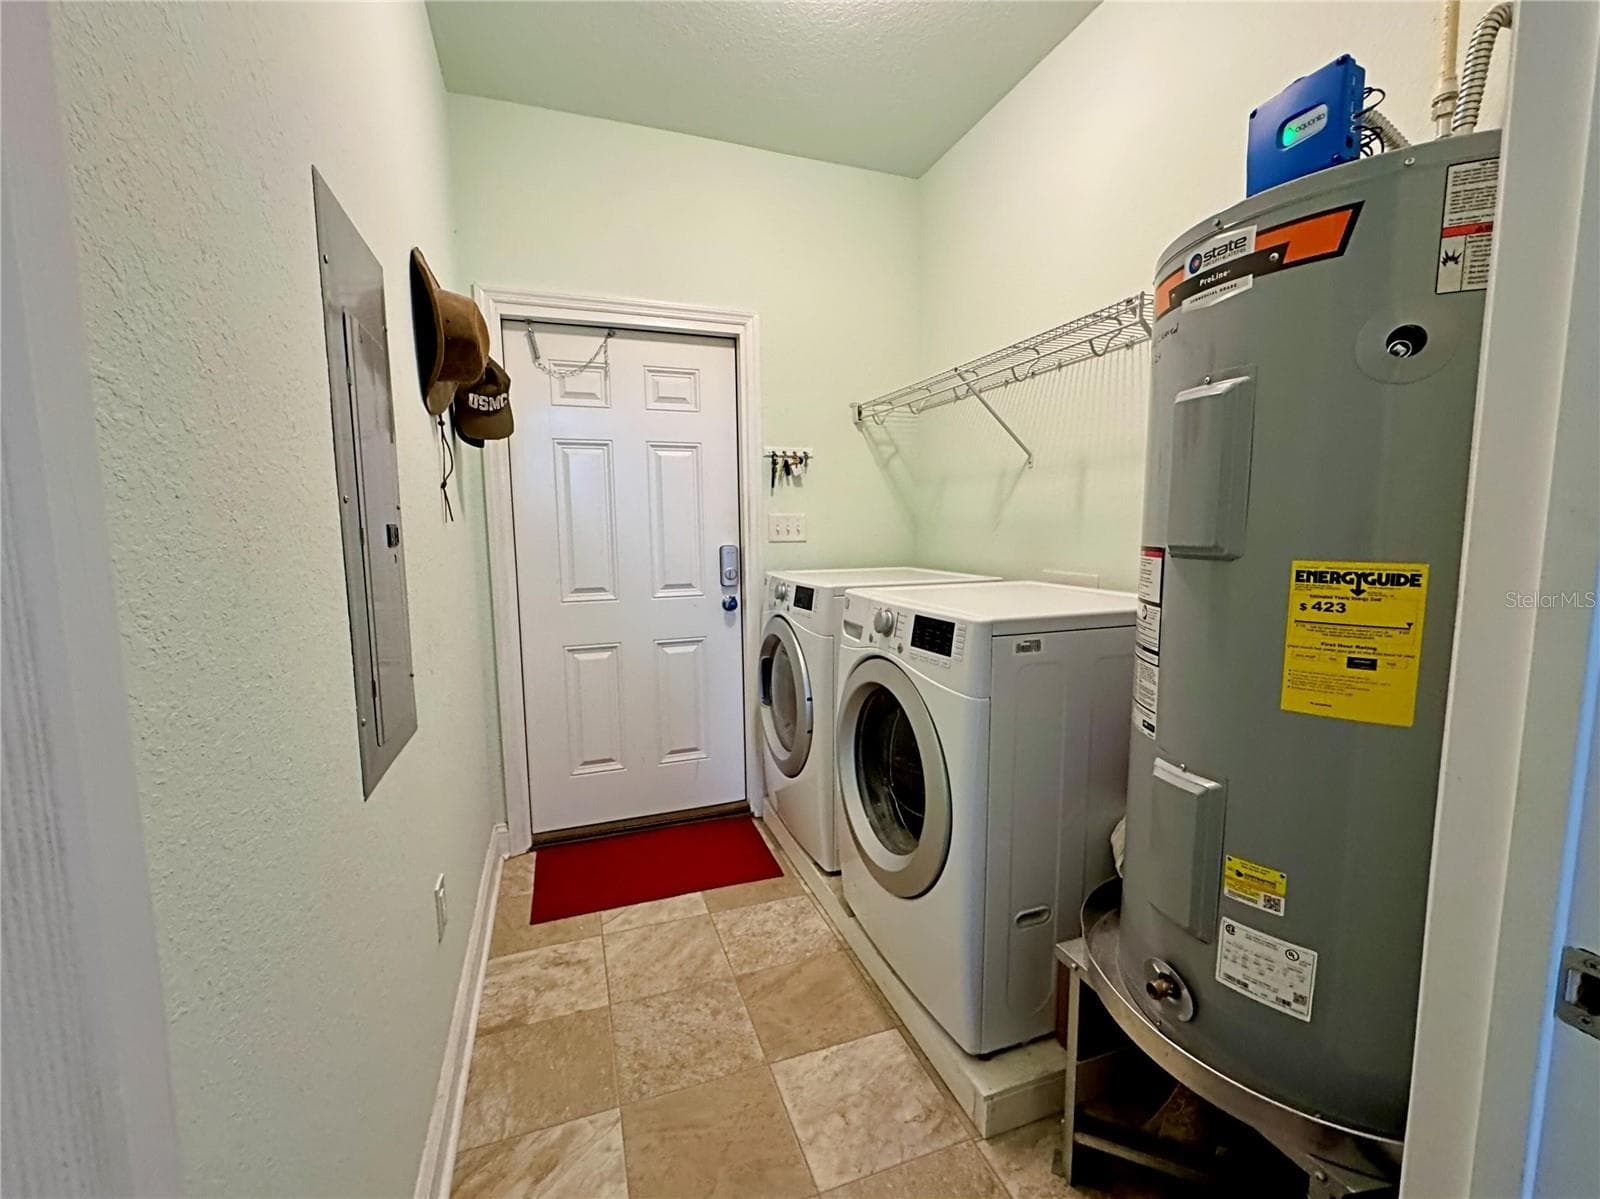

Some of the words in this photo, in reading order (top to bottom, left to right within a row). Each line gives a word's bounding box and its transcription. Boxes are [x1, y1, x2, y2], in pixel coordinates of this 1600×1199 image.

[1203, 236, 1247, 263] state
[468, 393, 508, 412] USMC
[1295, 569, 1423, 588] ENERGYGUIDE
[1311, 601, 1347, 613] 423
